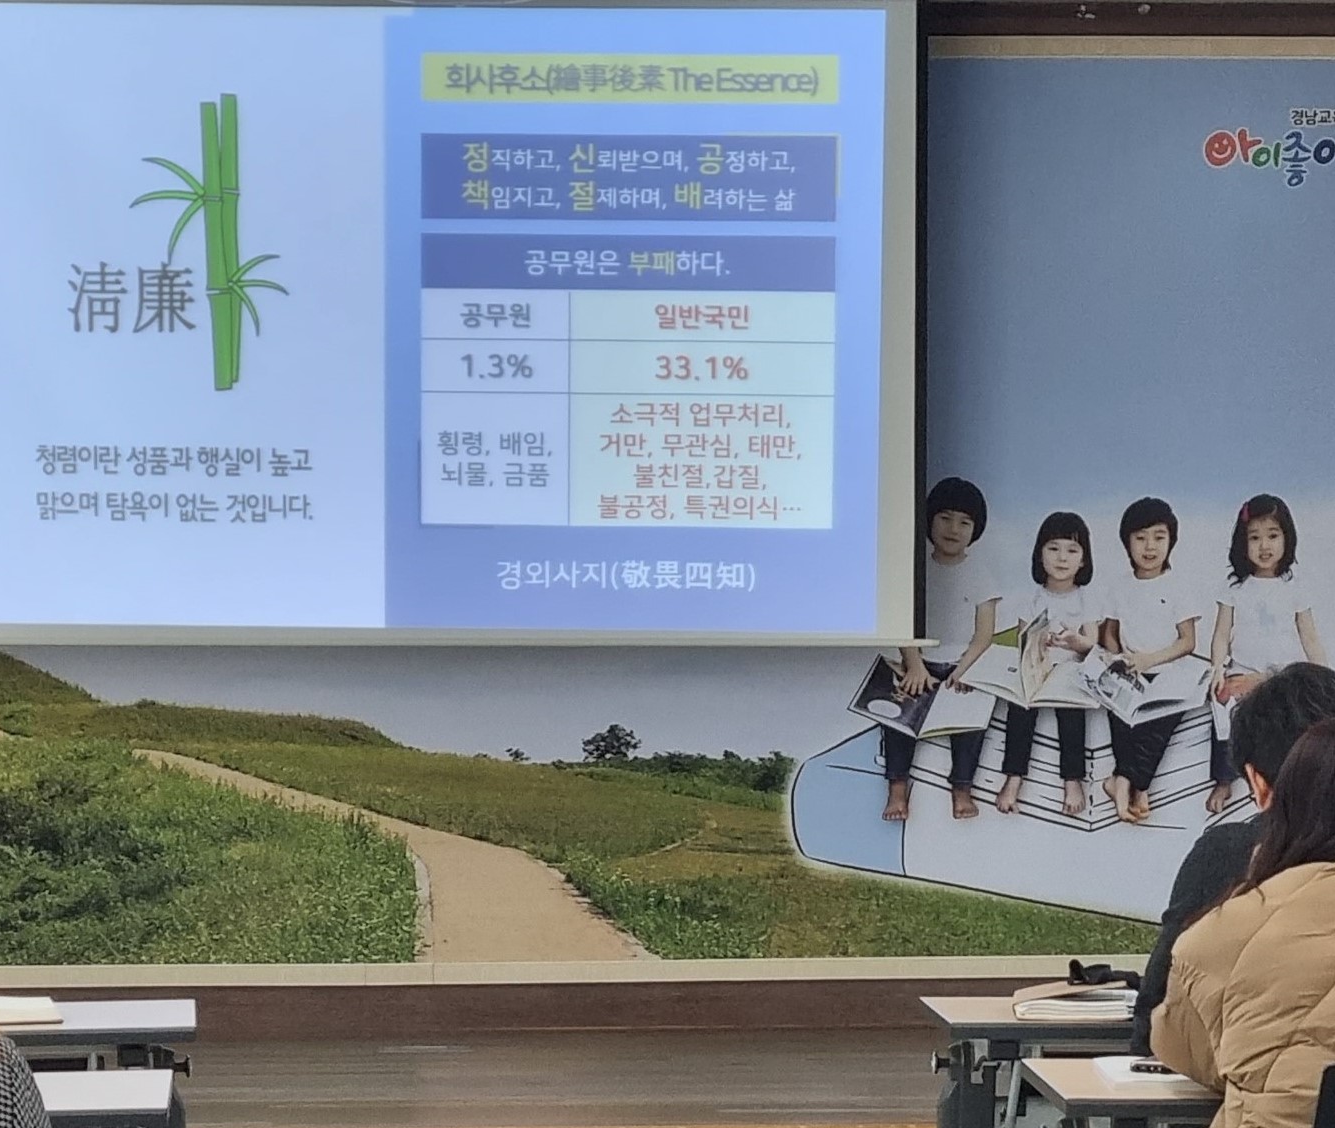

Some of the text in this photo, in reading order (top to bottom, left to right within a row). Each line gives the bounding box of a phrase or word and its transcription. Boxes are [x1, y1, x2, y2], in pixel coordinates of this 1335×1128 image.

[666, 66, 714, 92] The
[716, 66, 819, 96] Essence)
[462, 143, 796, 175] 정직하고, 신뢰받으며, 공정하고,
[462, 180, 796, 212] 책임지고, 절제하며, 배려하는 삶
[524, 250, 731, 276] 공무원은 부패하다.
[461, 303, 532, 329] 공무원
[654, 305, 750, 331] 일반국민
[461, 354, 533, 379] 1.3%
[655, 356, 749, 381] 33.1%
[610, 402, 791, 429] 소극적 업무처리,
[437, 430, 553, 457] 횡령, 배임,
[599, 432, 802, 460] 거만, 무관심, 태만,
[35, 445, 313, 478] 청렴이란 성품과 행실이 높고
[441, 461, 550, 488] 뇌물, 금품
[36, 491, 314, 523] 맑으며 탐욕이 없는 것입니다.
[597, 494, 675, 520] 불공정,
